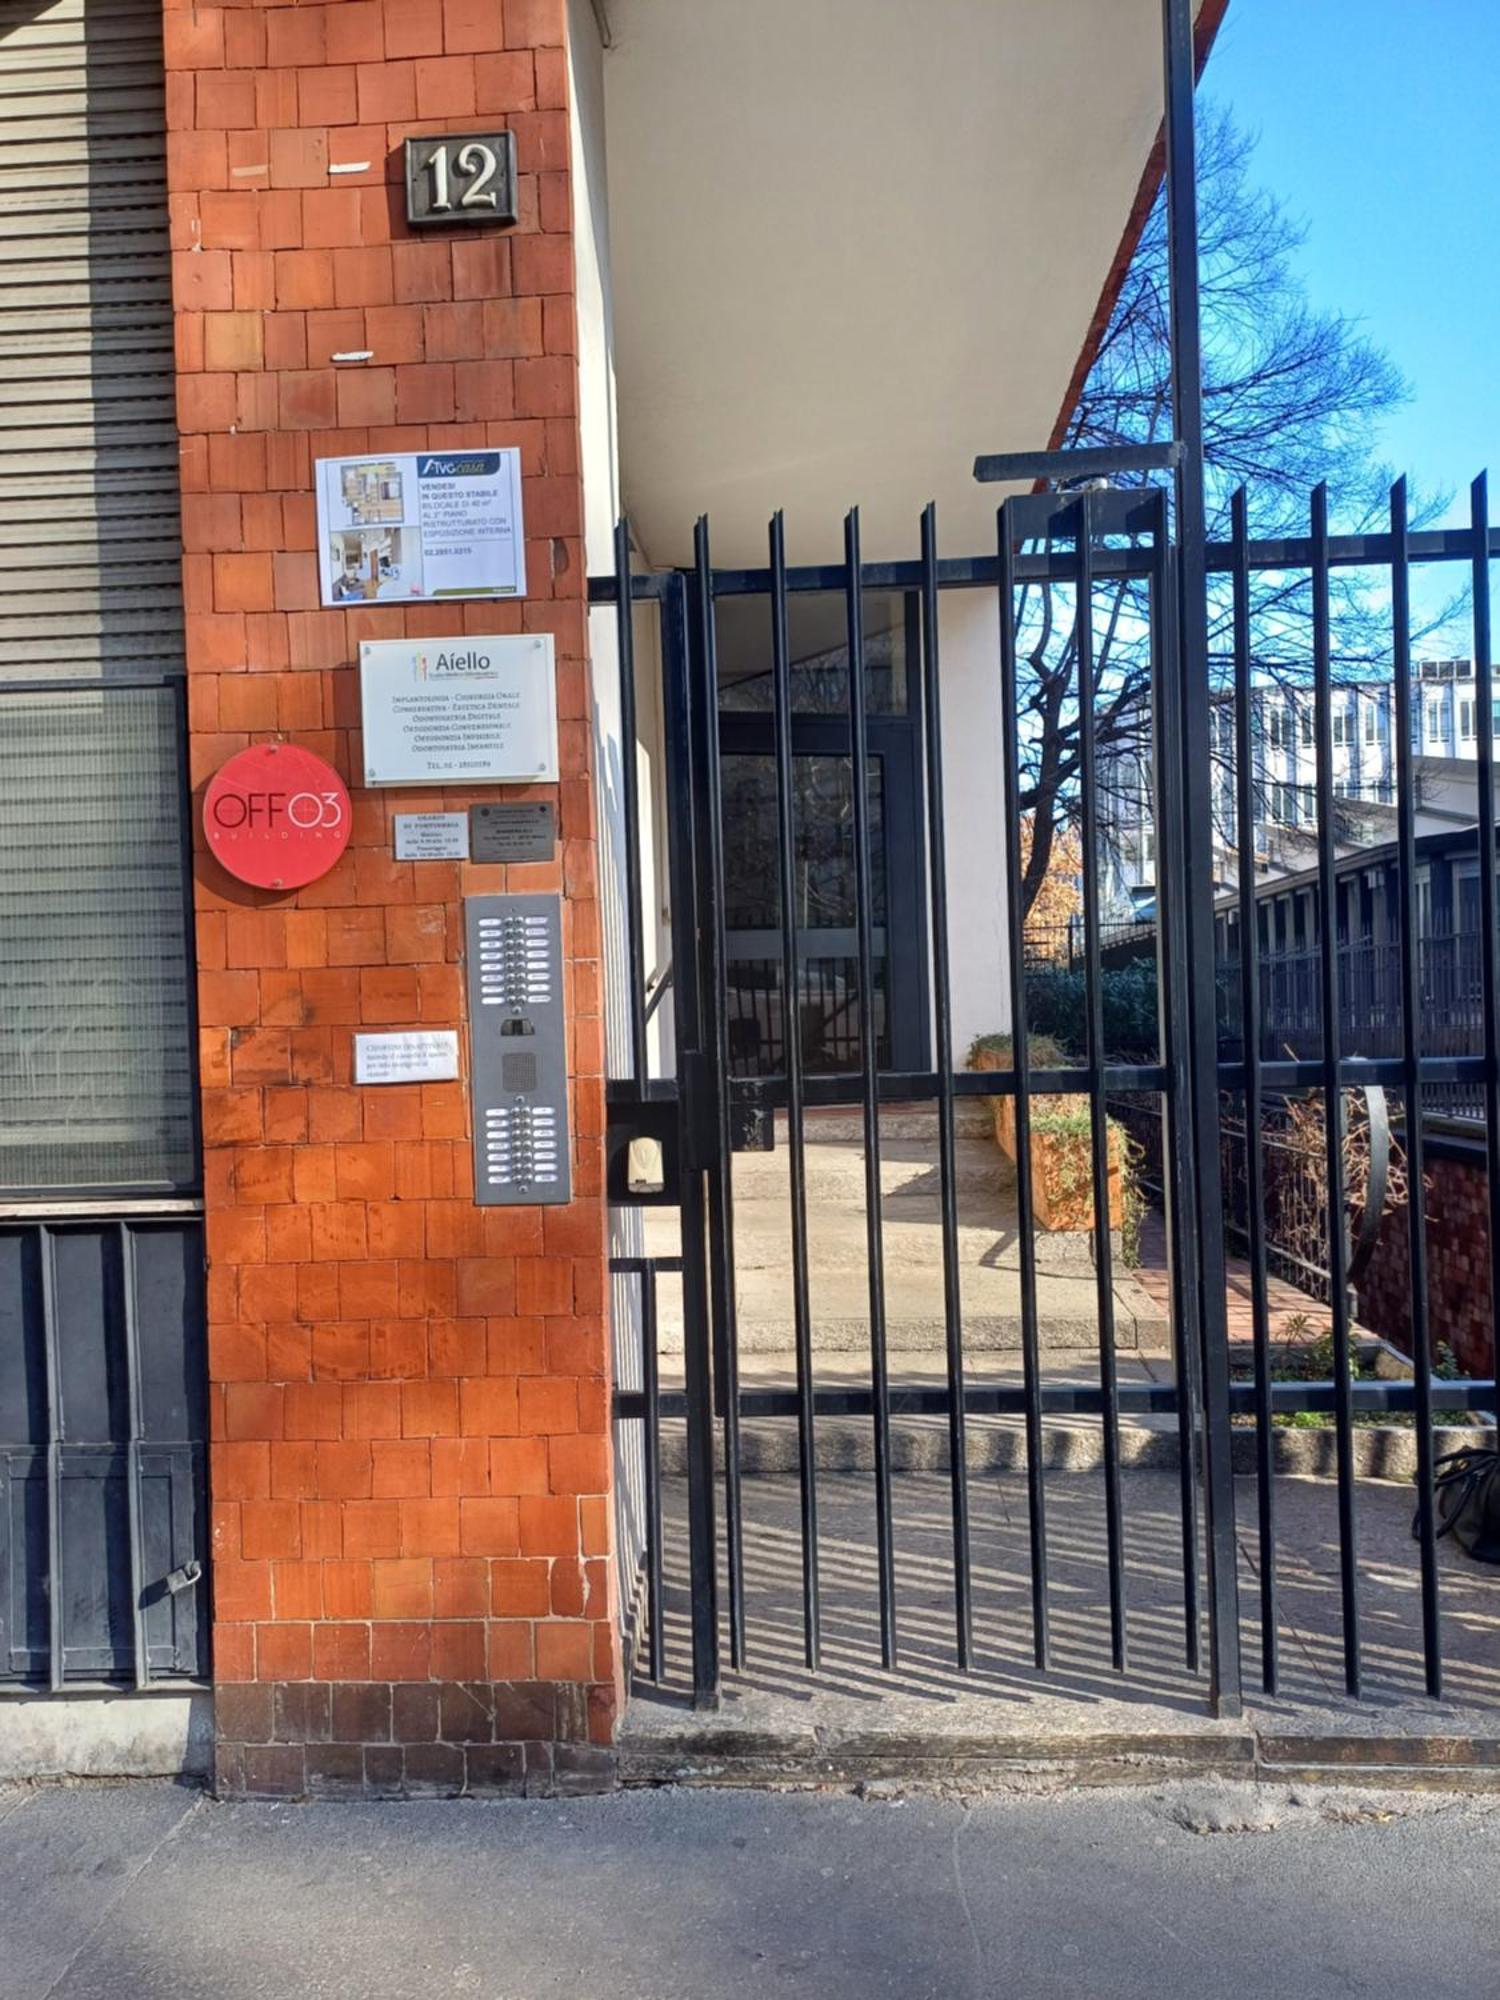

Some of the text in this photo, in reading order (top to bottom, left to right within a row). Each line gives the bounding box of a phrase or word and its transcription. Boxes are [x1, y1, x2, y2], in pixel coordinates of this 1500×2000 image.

[428, 144, 497, 209] 12
[421, 482, 455, 491] VENDESI
[431, 491, 464, 499] QUESTO
[465, 489, 498, 498] STABILE
[213, 831, 341, 839] BUILDING
